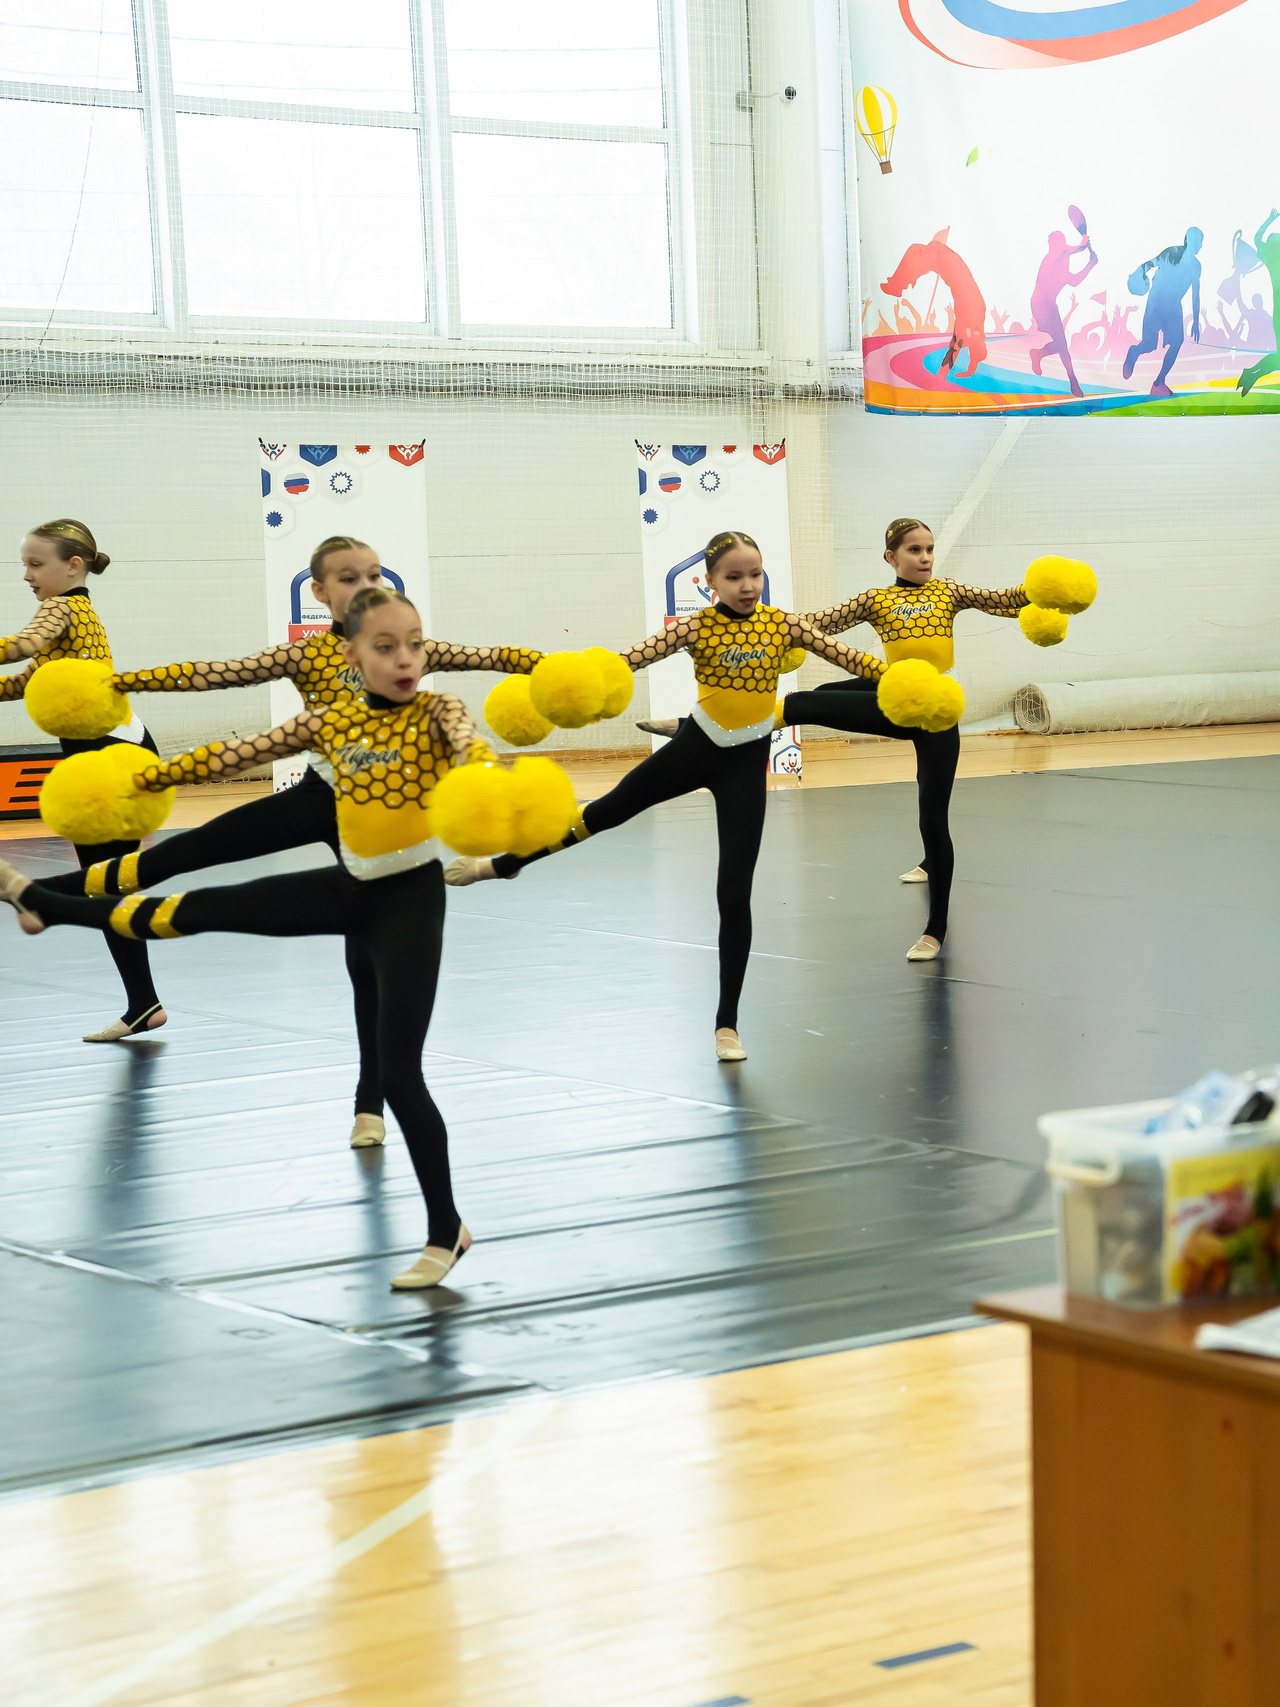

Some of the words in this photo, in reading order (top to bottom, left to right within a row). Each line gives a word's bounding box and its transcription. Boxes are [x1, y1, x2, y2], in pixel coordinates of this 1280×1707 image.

[890, 603, 932, 621] Идеал
[717, 646, 767, 670] Идеал
[335, 743, 400, 778] Идеал
